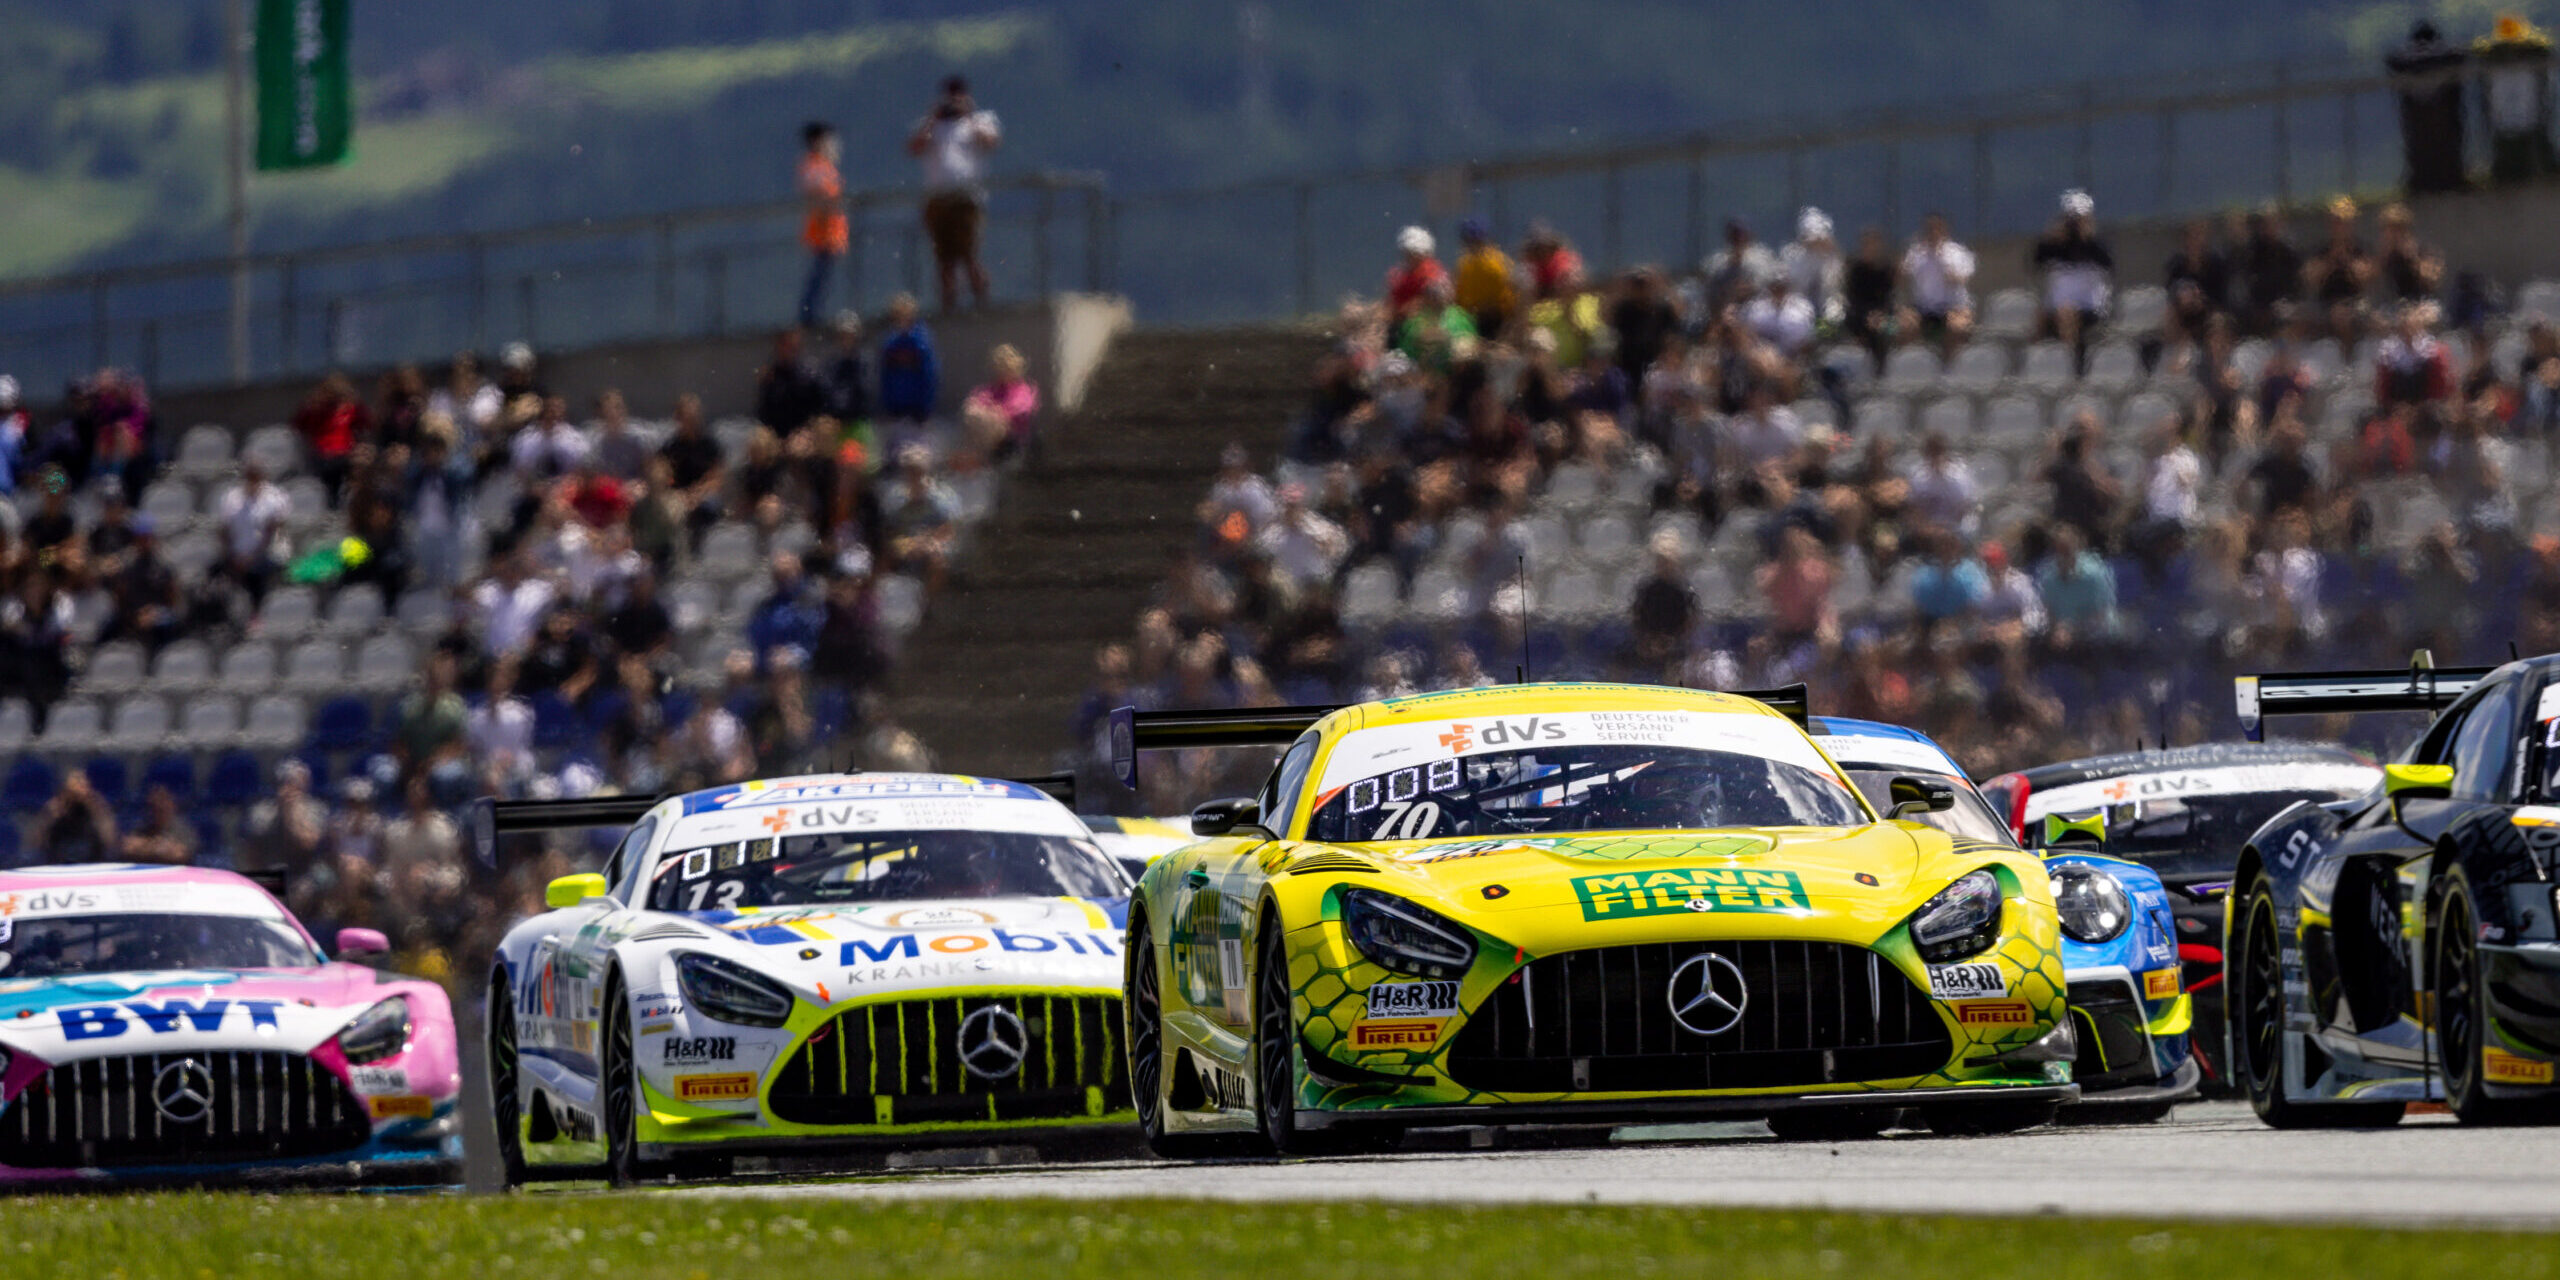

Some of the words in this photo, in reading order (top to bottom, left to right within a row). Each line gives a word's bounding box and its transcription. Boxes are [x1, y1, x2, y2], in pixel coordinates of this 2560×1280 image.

[1590, 713, 1689, 724] DEUTSCHER
[1593, 723, 1674, 733] VERSAND
[1597, 732, 1668, 742] SERVICE
[1371, 802, 1440, 840] 70
[1584, 870, 1789, 893] MANN
[688, 880, 745, 911] 13
[1591, 885, 1801, 913] FILTER
[840, 928, 1117, 966] Mobil
[1927, 966, 1974, 989] H&R
[1371, 985, 1425, 1009] H&R
[56, 998, 285, 1042] BWT
[1959, 1003, 2026, 1023] PIRELLI
[1357, 1023, 1437, 1045] PIRELLI
[664, 1037, 707, 1059] H&R
[682, 1077, 749, 1097] PIRELLI
